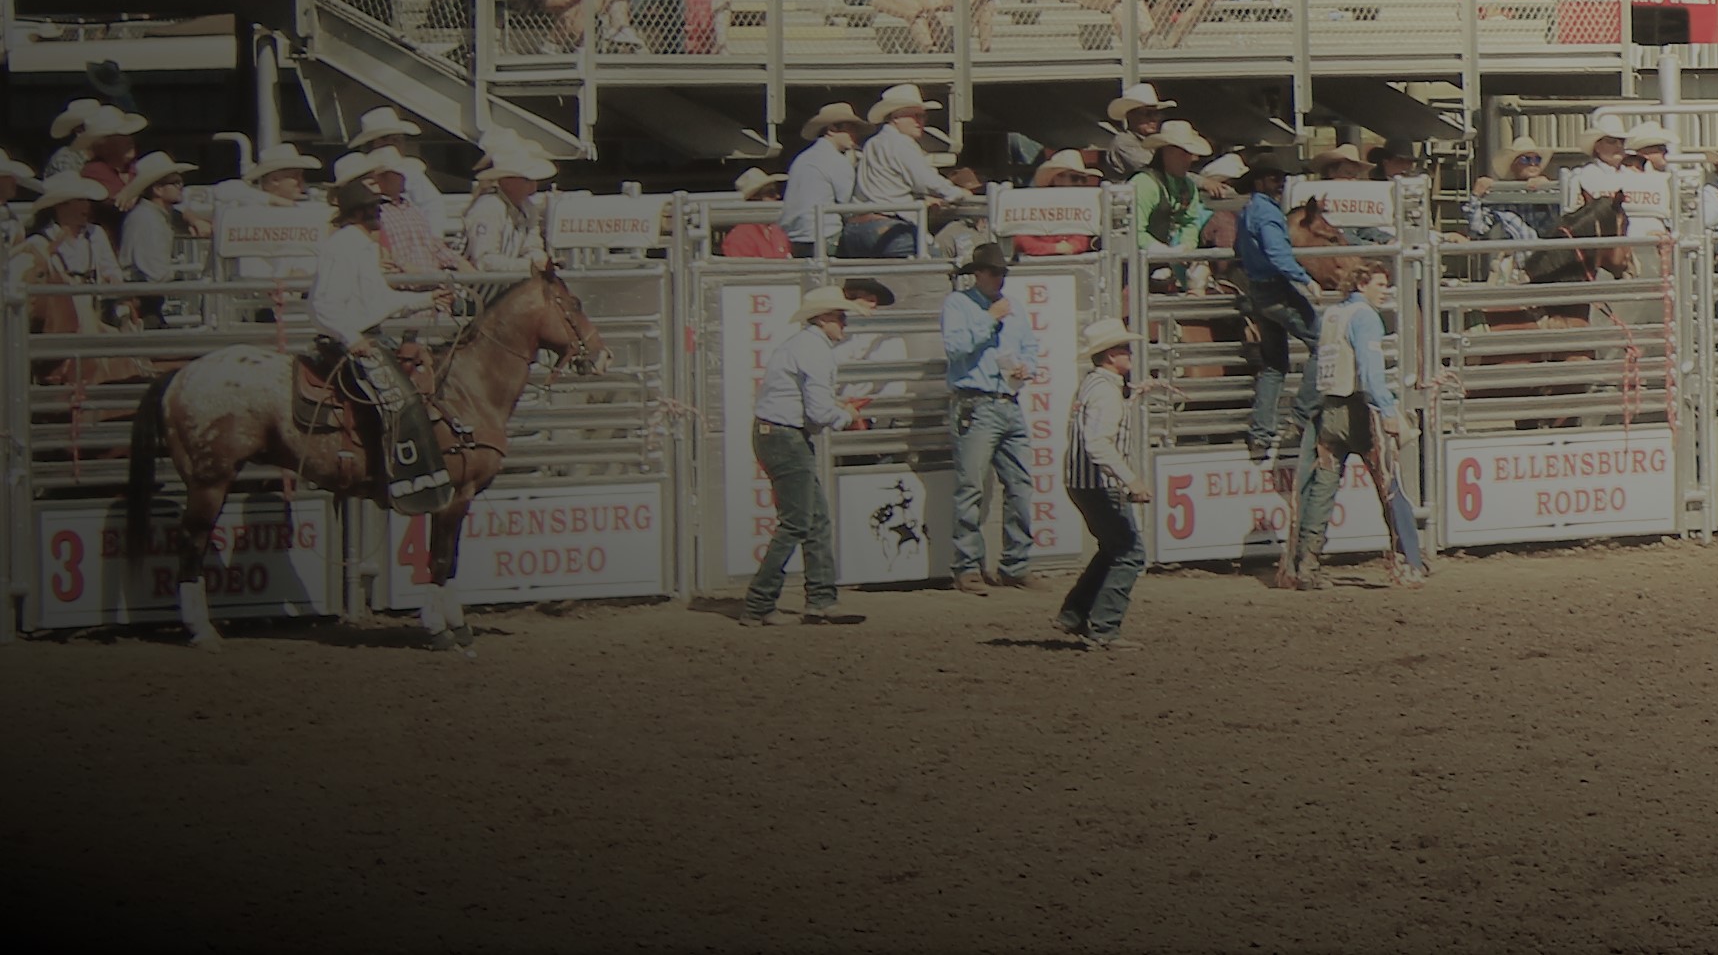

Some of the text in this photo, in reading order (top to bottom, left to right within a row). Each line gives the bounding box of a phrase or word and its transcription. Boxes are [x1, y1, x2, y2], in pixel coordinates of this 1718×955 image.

[559, 217, 650, 234] ELLENSBURG
[1004, 207, 1093, 222] ELLENSBURG
[228, 227, 319, 243] ELLENSBURG
[1457, 449, 1667, 521] 6 ELLENSBURG
[1167, 473, 1195, 530] 5
[1251, 501, 1346, 531] ROO
[1537, 487, 1627, 515] RODEO
[397, 504, 652, 585] 4 LLENSBURG
[51, 530, 84, 602] 3
[495, 546, 606, 577] RODEO
[153, 564, 268, 597] RDEO
